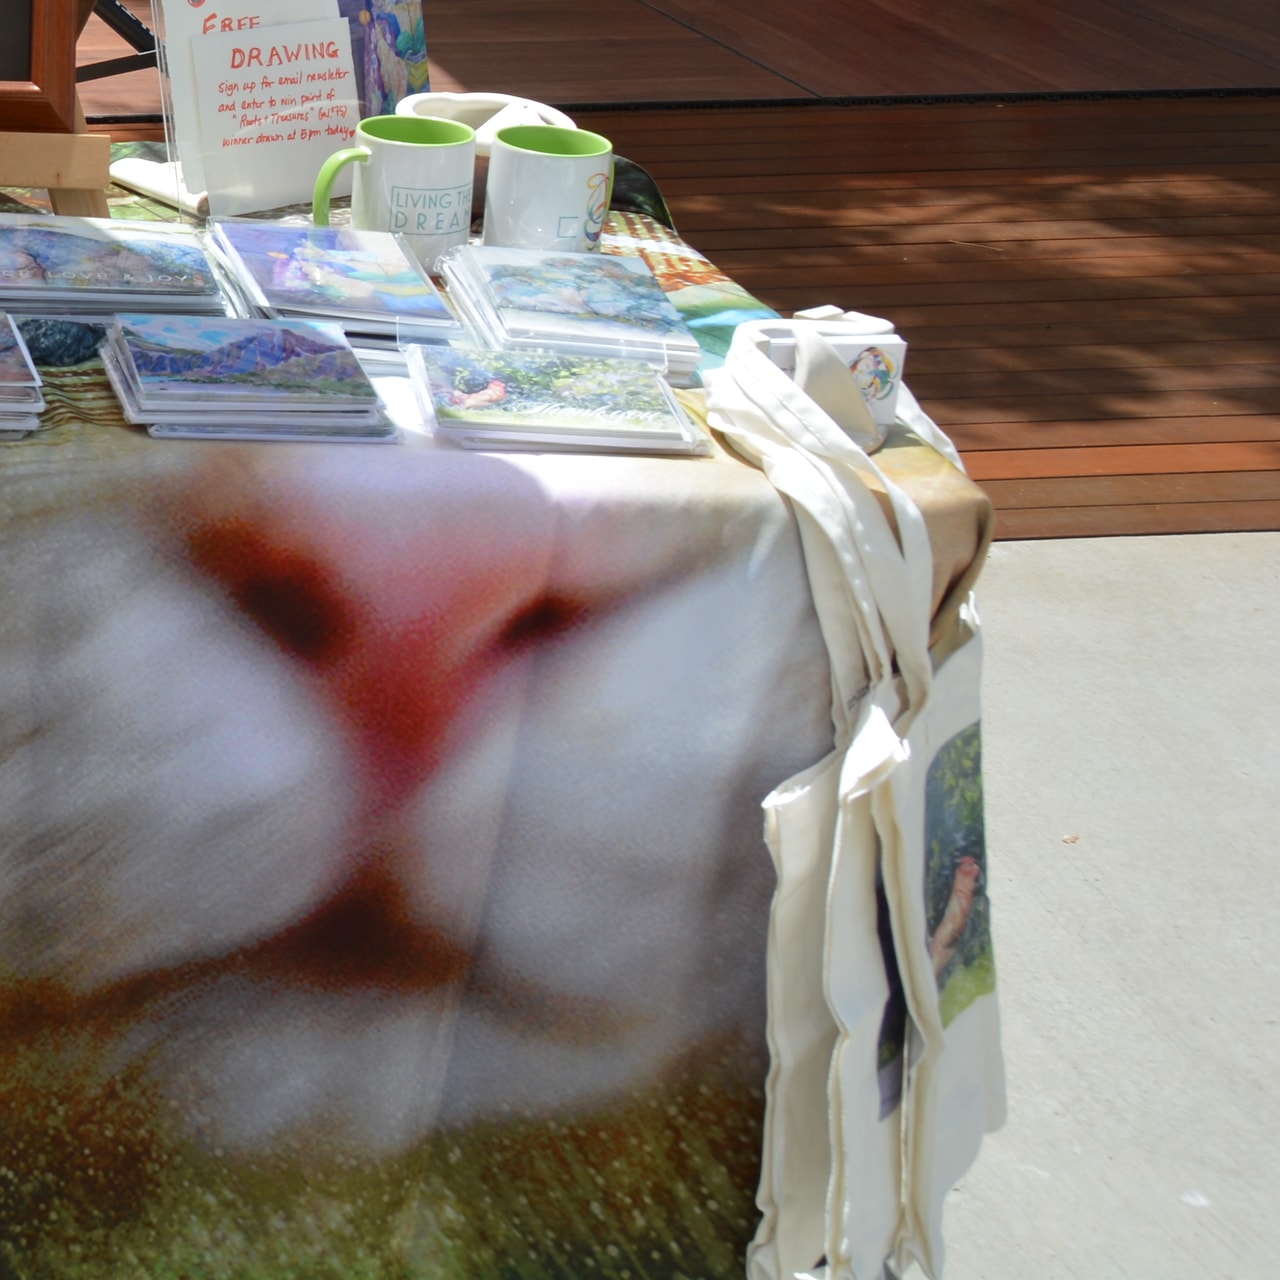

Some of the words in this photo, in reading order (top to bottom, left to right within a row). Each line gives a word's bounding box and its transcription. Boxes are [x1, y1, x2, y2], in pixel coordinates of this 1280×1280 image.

[230, 41, 340, 69] DRAWING
[218, 80, 239, 97] sign
[243, 81, 256, 93] up
[261, 75, 274, 90] for
[278, 71, 303, 86] email
[307, 67, 350, 83] newsletter
[218, 101, 236, 113] and
[241, 99, 265, 112] enter
[268, 96, 277, 107] to
[281, 94, 297, 106] win
[326, 88, 336, 101] of
[222, 134, 254, 148] winner
[255, 132, 284, 145] drawn
[287, 130, 296, 141] at
[325, 124, 350, 142] today
[395, 192, 453, 209] LIVING
[48, 269, 108, 280] LOVE
[145, 273, 188, 283] JOY
